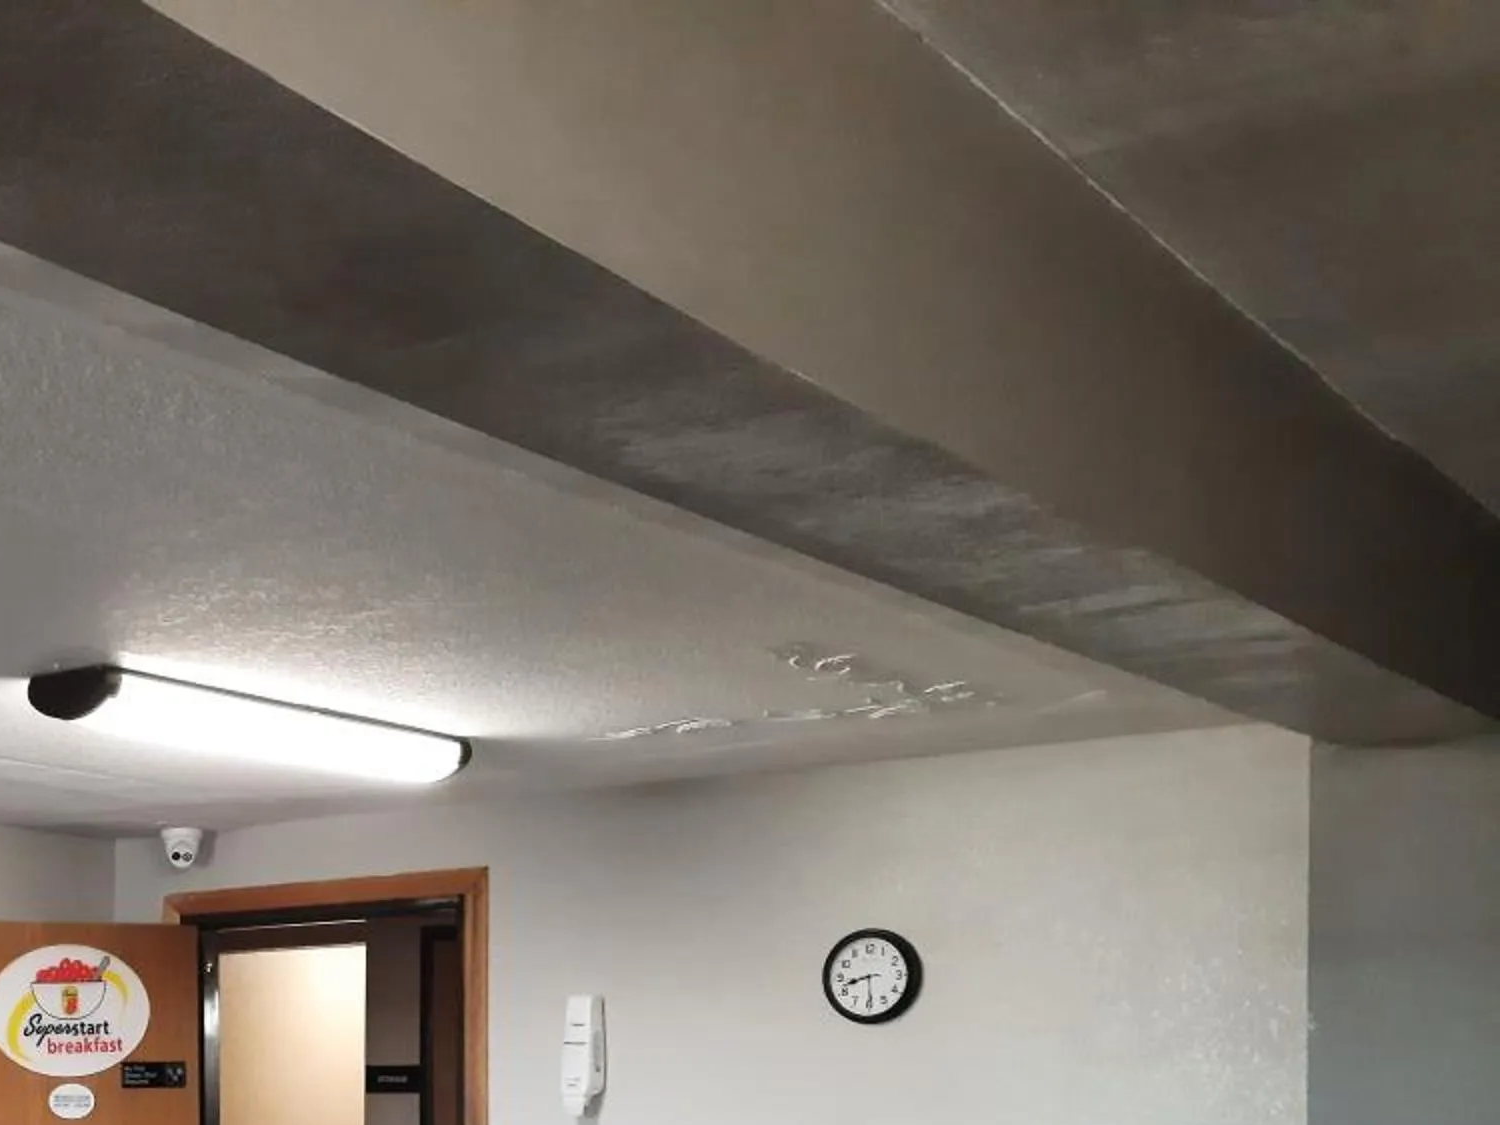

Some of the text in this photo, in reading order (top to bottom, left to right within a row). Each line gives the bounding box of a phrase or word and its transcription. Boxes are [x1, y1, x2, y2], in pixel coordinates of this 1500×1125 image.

[891, 956, 899, 966] 2
[895, 969, 902, 980] 3
[852, 996, 859, 1006] 7
[23, 1013, 110, 1047] Superstart
[47, 1036, 123, 1054] breakfast
